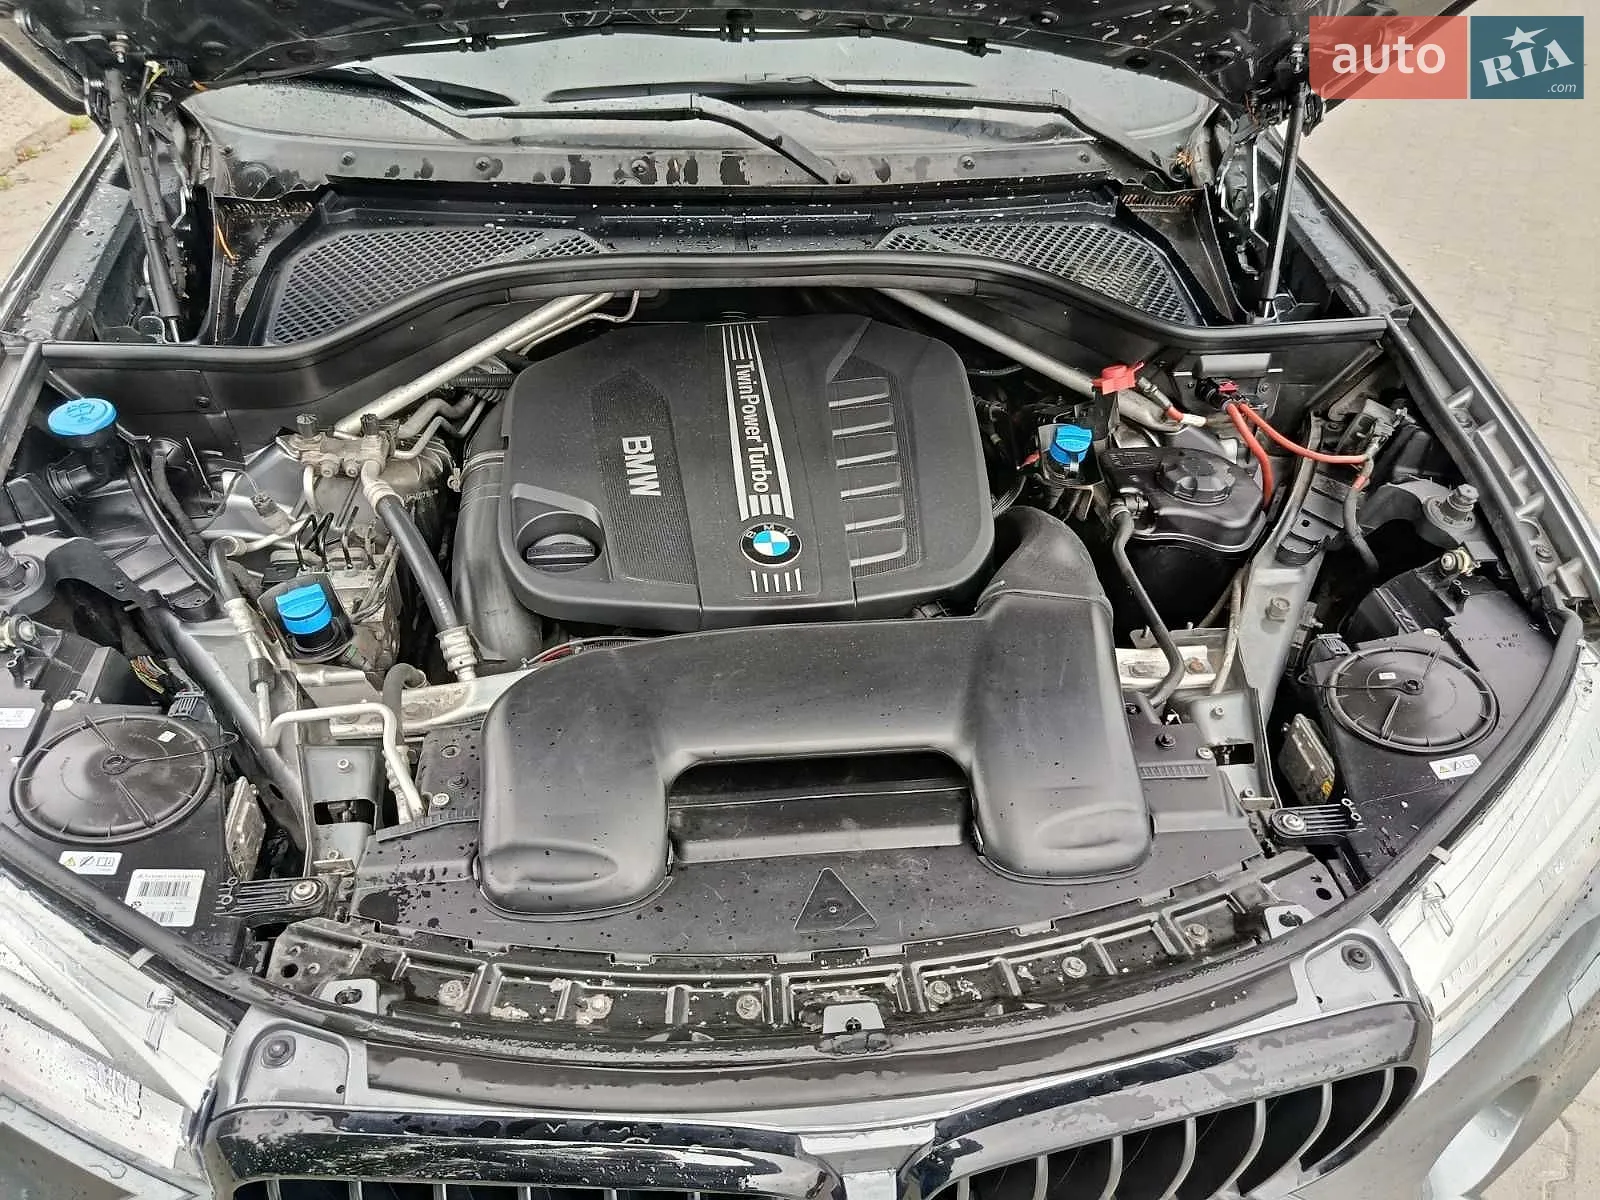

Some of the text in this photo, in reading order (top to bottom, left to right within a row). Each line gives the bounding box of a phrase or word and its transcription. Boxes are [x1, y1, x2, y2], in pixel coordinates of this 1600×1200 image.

[622, 435, 661, 497] BMW
[736, 361, 772, 493] TwinPower Turbo
